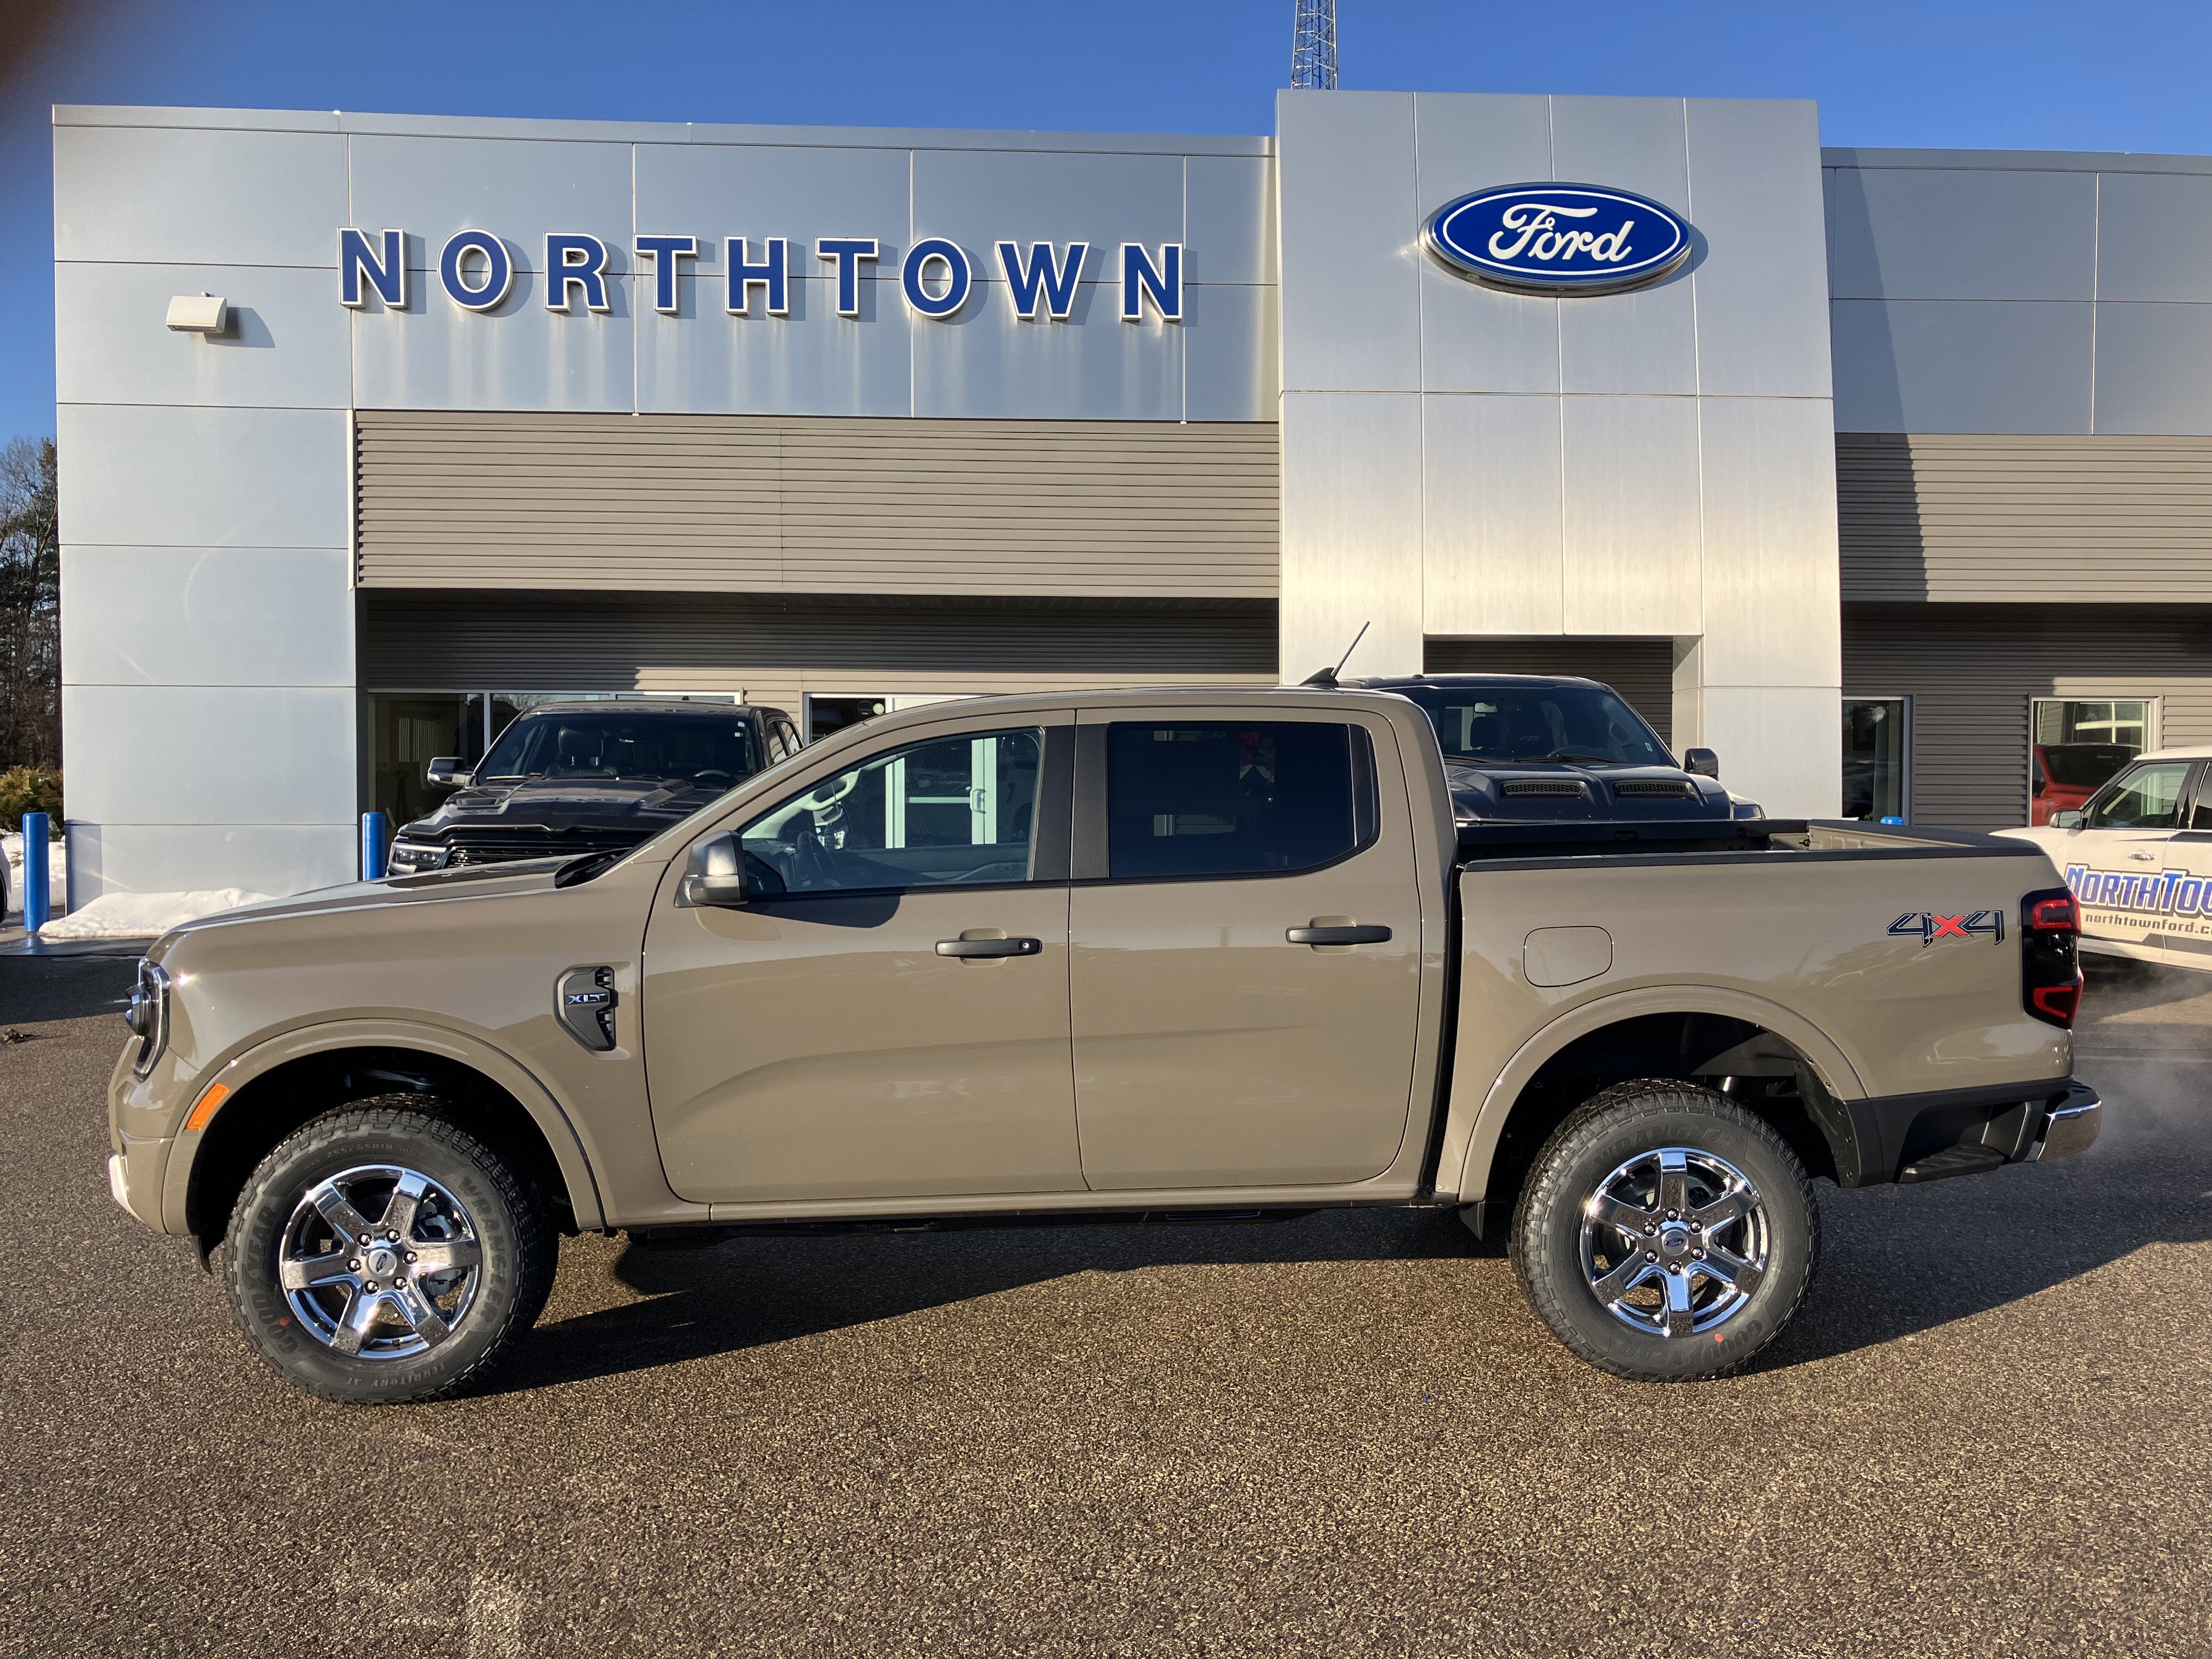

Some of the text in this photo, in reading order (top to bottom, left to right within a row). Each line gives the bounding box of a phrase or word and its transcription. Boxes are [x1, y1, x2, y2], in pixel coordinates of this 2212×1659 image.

[1488, 204, 1635, 262] Ford
[338, 226, 1183, 323] NORTHTOWN
[2064, 864, 2212, 917] NORTHTO
[2085, 913, 2212, 935] northtownford.c
[568, 993, 606, 1005] XLT
[459, 1177, 507, 1323] WRANGLER
[247, 1206, 297, 1354] GOODYEAR
[371, 1362, 448, 1387] TERRITORY
